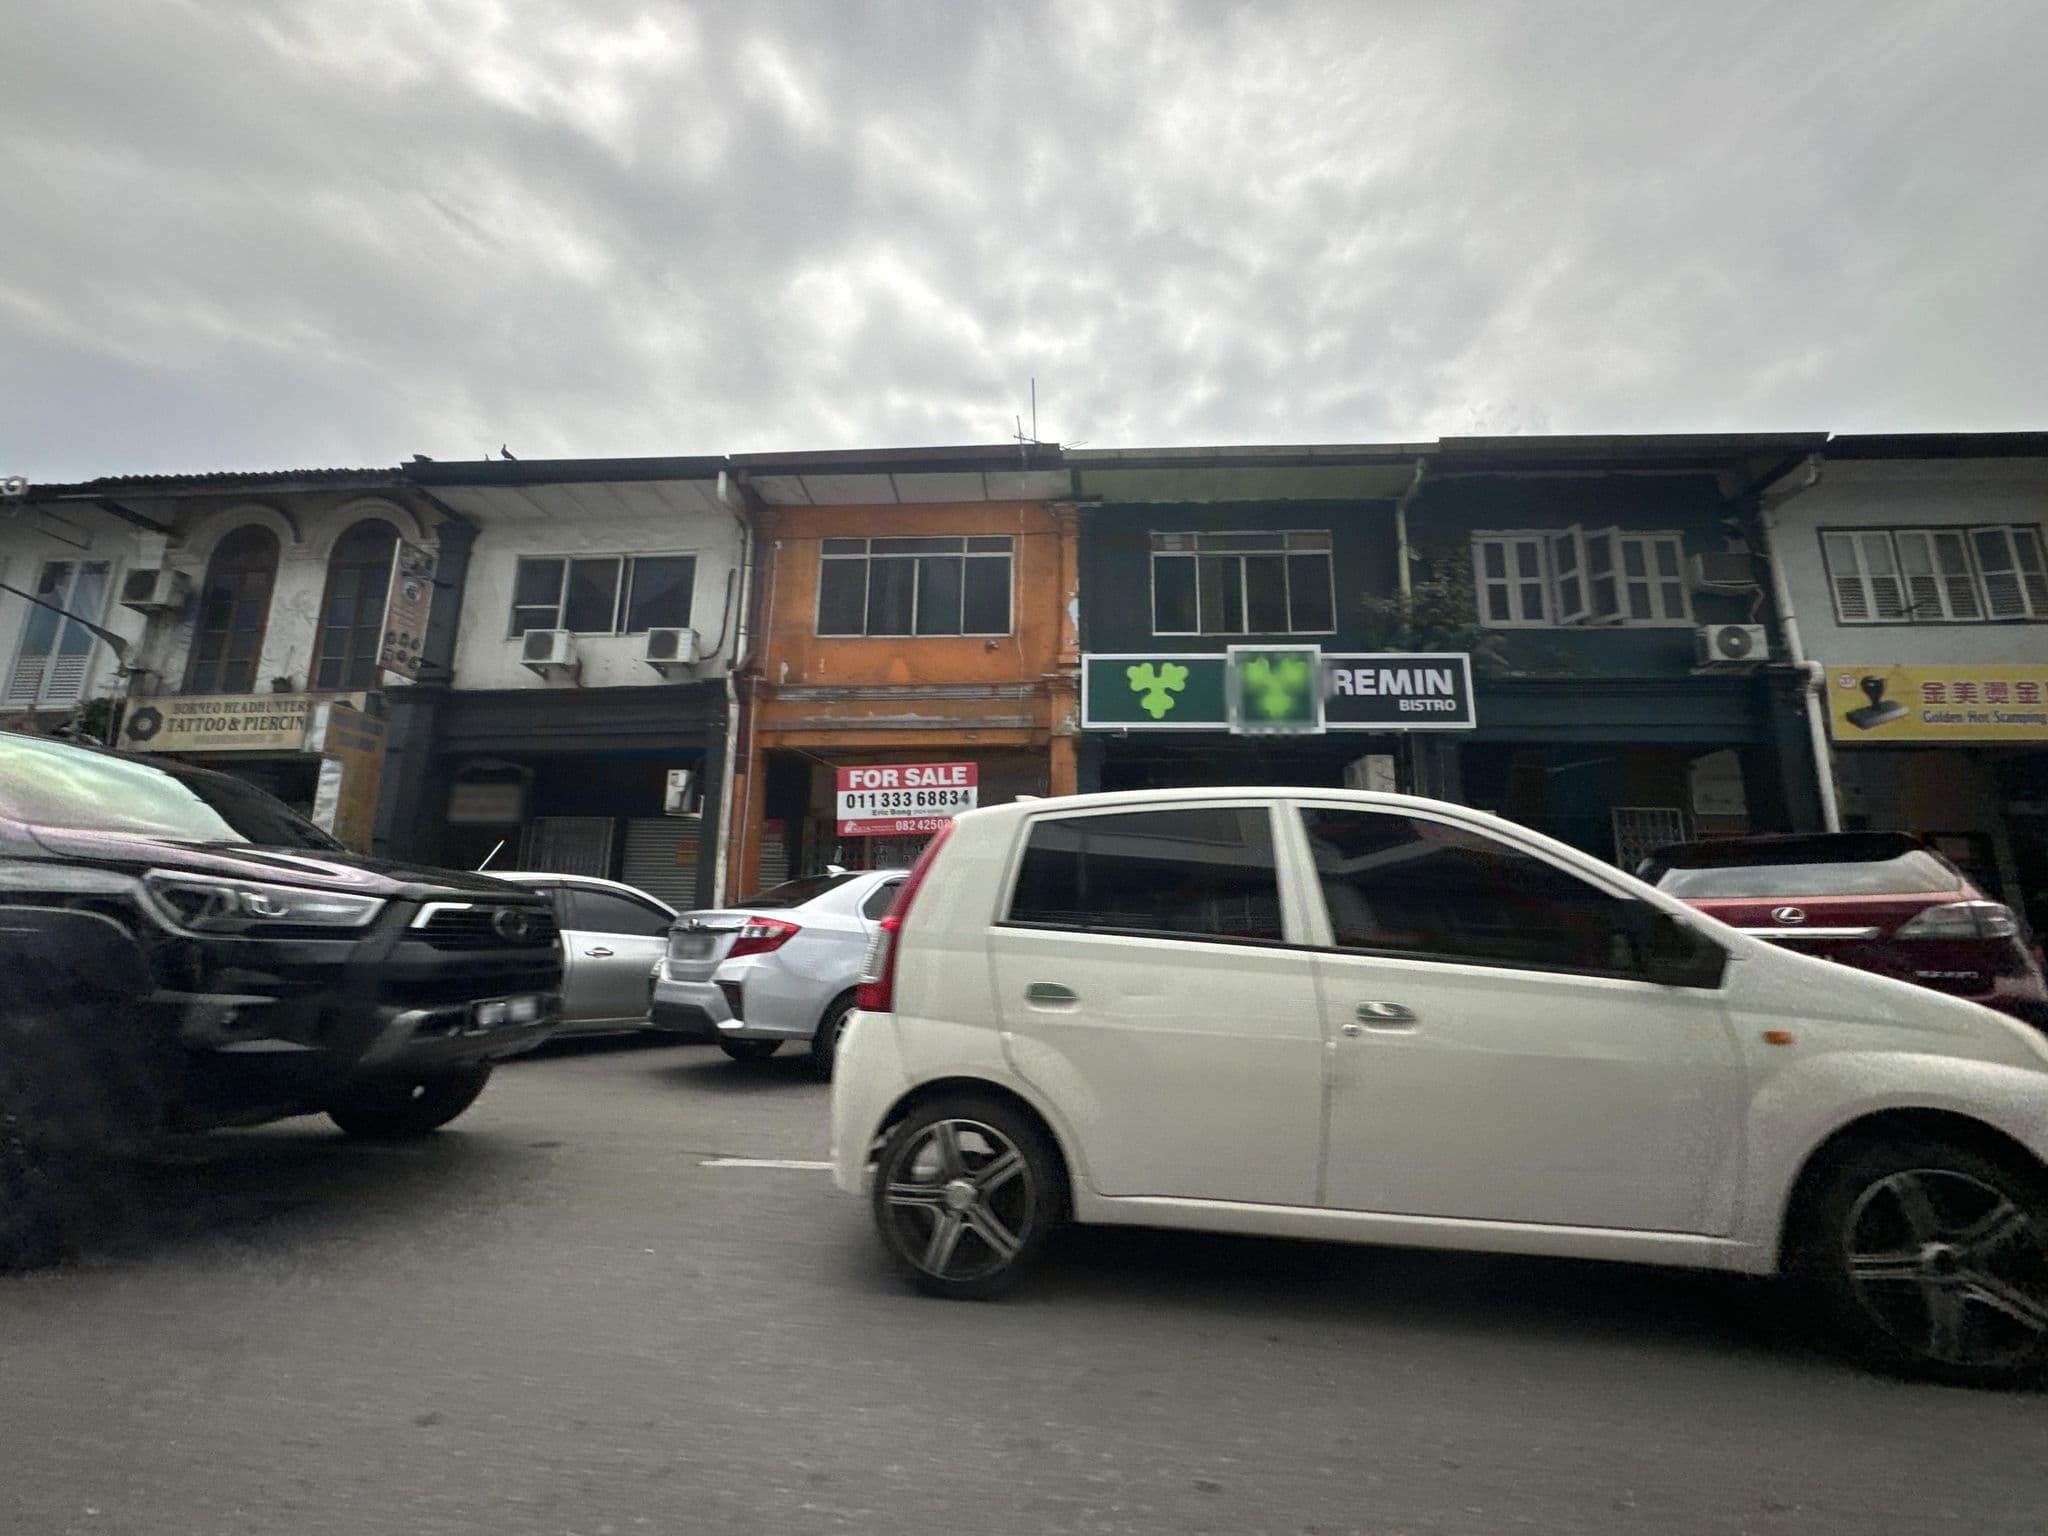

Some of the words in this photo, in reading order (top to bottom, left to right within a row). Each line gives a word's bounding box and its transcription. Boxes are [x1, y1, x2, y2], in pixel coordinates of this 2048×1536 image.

[1400, 700, 1457, 712] BISTRO
[167, 717, 227, 733] TATTOO
[228, 717, 242, 731] &
[849, 769, 899, 789] FOR
[905, 766, 968, 786] SALE
[895, 820, 915, 831] 082
